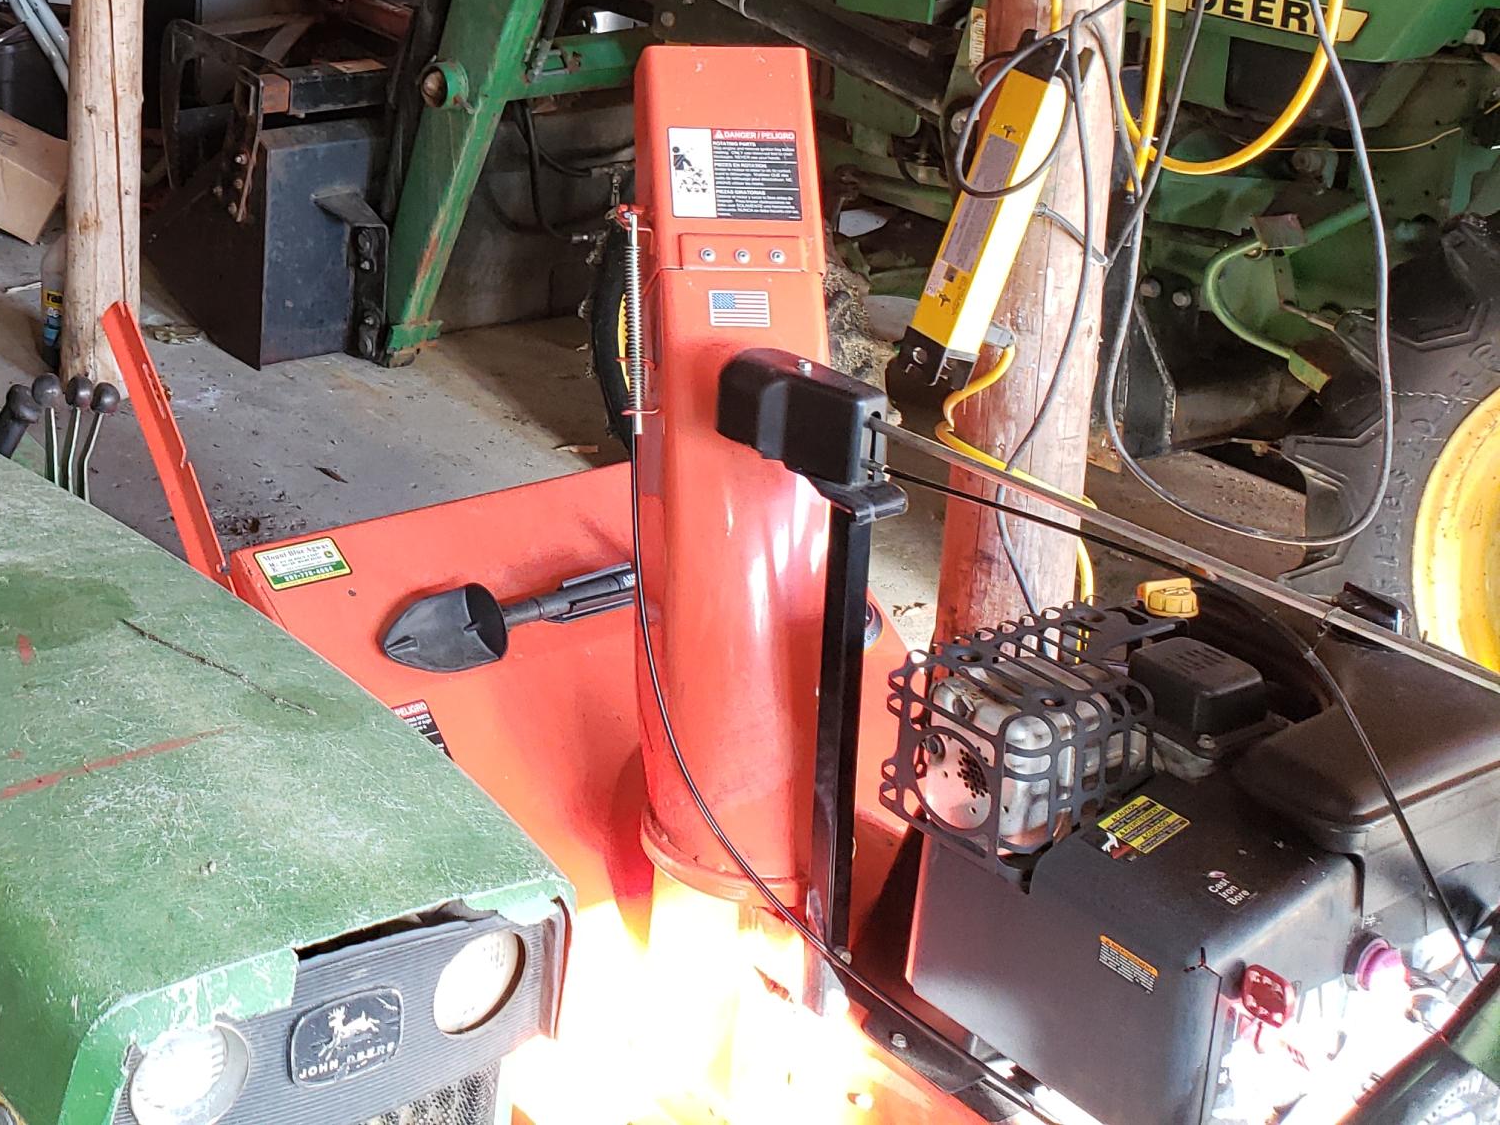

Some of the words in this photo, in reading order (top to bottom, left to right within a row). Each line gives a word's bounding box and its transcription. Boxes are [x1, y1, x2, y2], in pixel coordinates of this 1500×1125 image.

[723, 130, 757, 139] DANGER
[761, 131, 795, 140] PELIGRO
[1207, 878, 1231, 893] Cast
[1217, 885, 1240, 899] Iron
[1226, 890, 1251, 906] Bore
[298, 1058, 339, 1080] JOHN
[346, 1041, 396, 1064] DEERE
